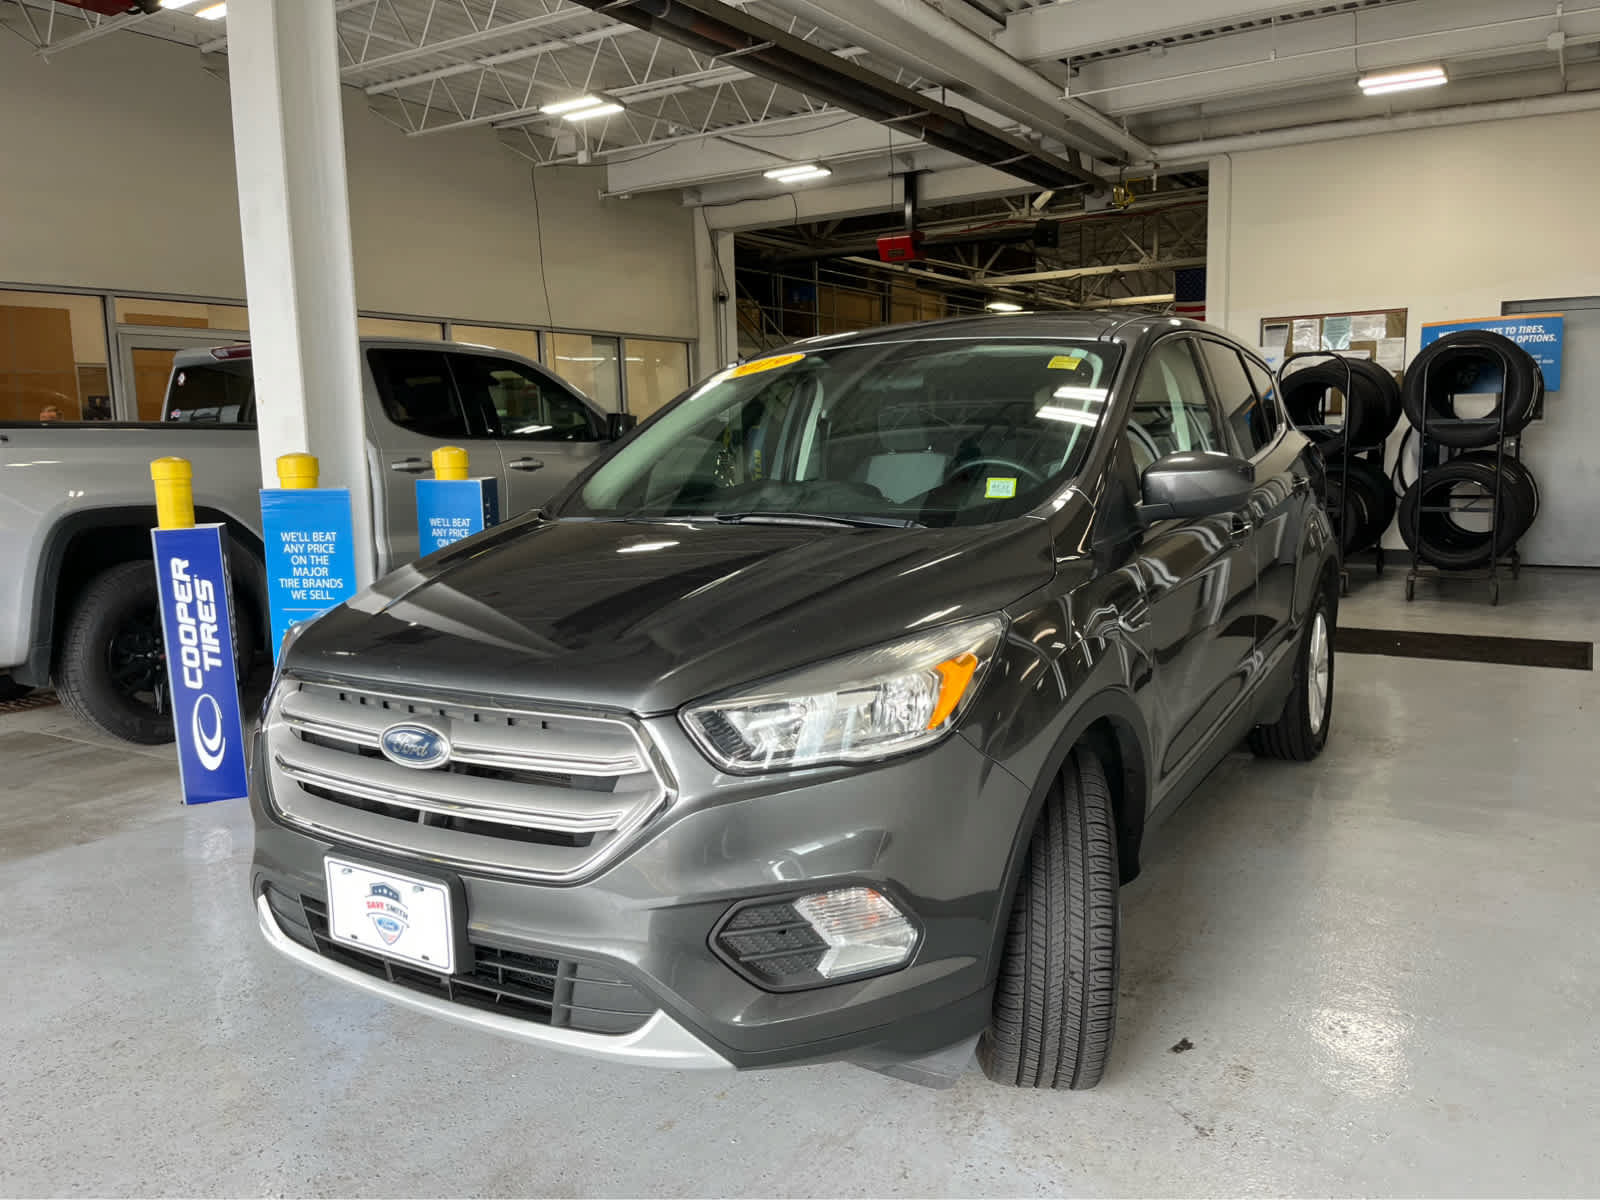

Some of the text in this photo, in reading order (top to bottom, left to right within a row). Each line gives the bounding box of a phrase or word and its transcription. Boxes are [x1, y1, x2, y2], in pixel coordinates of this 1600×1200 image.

[1505, 326, 1517, 335] TO
[1518, 324, 1545, 334] TIRES,
[1516, 333, 1557, 343] OPTIONS.
[428, 518, 471, 527] WE'LL BEAT
[280, 531, 336, 542] WE'LL BEAT
[432, 528, 470, 538] ANY PRICE
[283, 543, 336, 554] ANY PRICE
[290, 555, 329, 566] ON THE
[293, 566, 329, 577] MAJOR
[279, 578, 343, 589] TIRE BRANDS
[291, 590, 335, 600] WE SELL.
[170, 557, 203, 689] COOPER
[194, 577, 223, 672] TIRES
